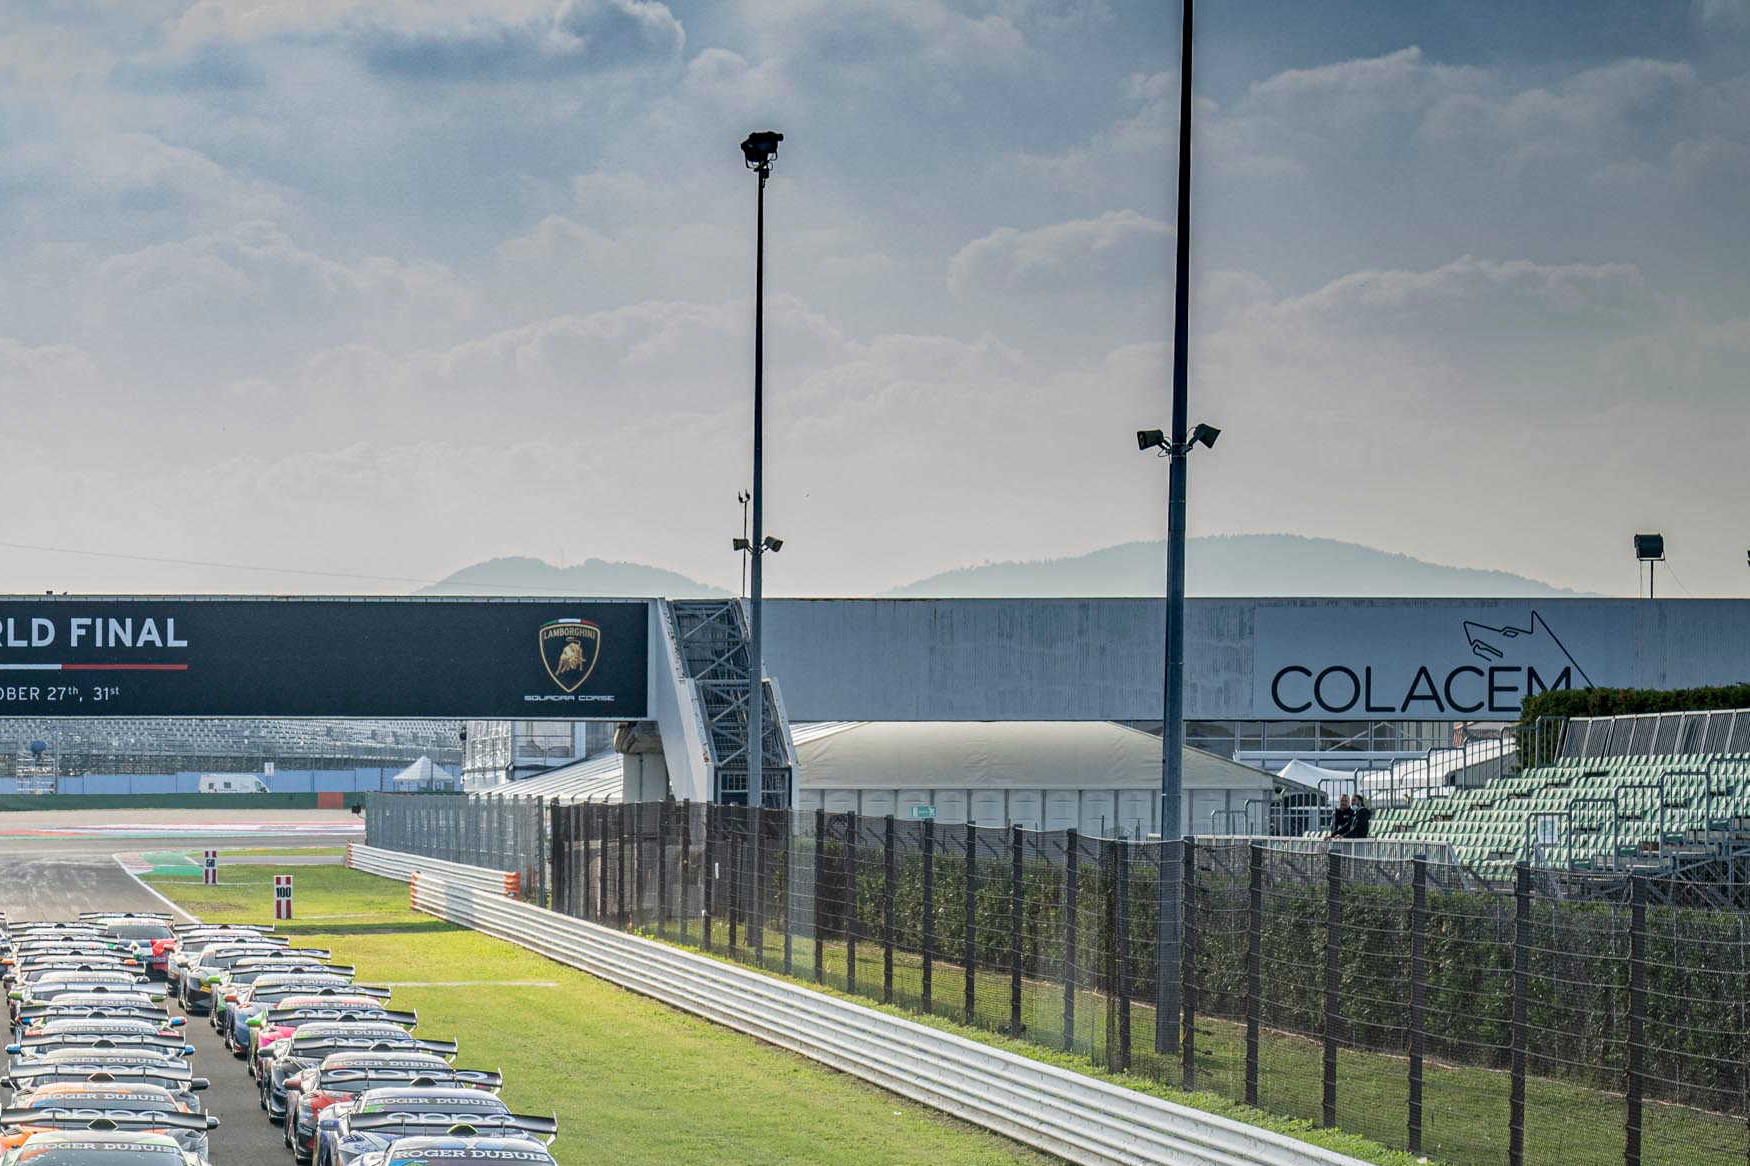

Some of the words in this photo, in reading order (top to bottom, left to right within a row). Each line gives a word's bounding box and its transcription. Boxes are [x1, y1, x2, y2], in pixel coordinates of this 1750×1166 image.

[70, 617, 188, 647] FINAL
[543, 627, 596, 640] LAMBORGHINI
[93, 686, 120, 701] 31st
[205, 858, 216, 868] 50
[276, 886, 292, 898] 100
[34, 1142, 97, 1151] ROGER
[103, 1143, 177, 1153] DUBUIS
[395, 1150, 466, 1160] ROGER
[470, 1150, 549, 1162] DUBUIS
